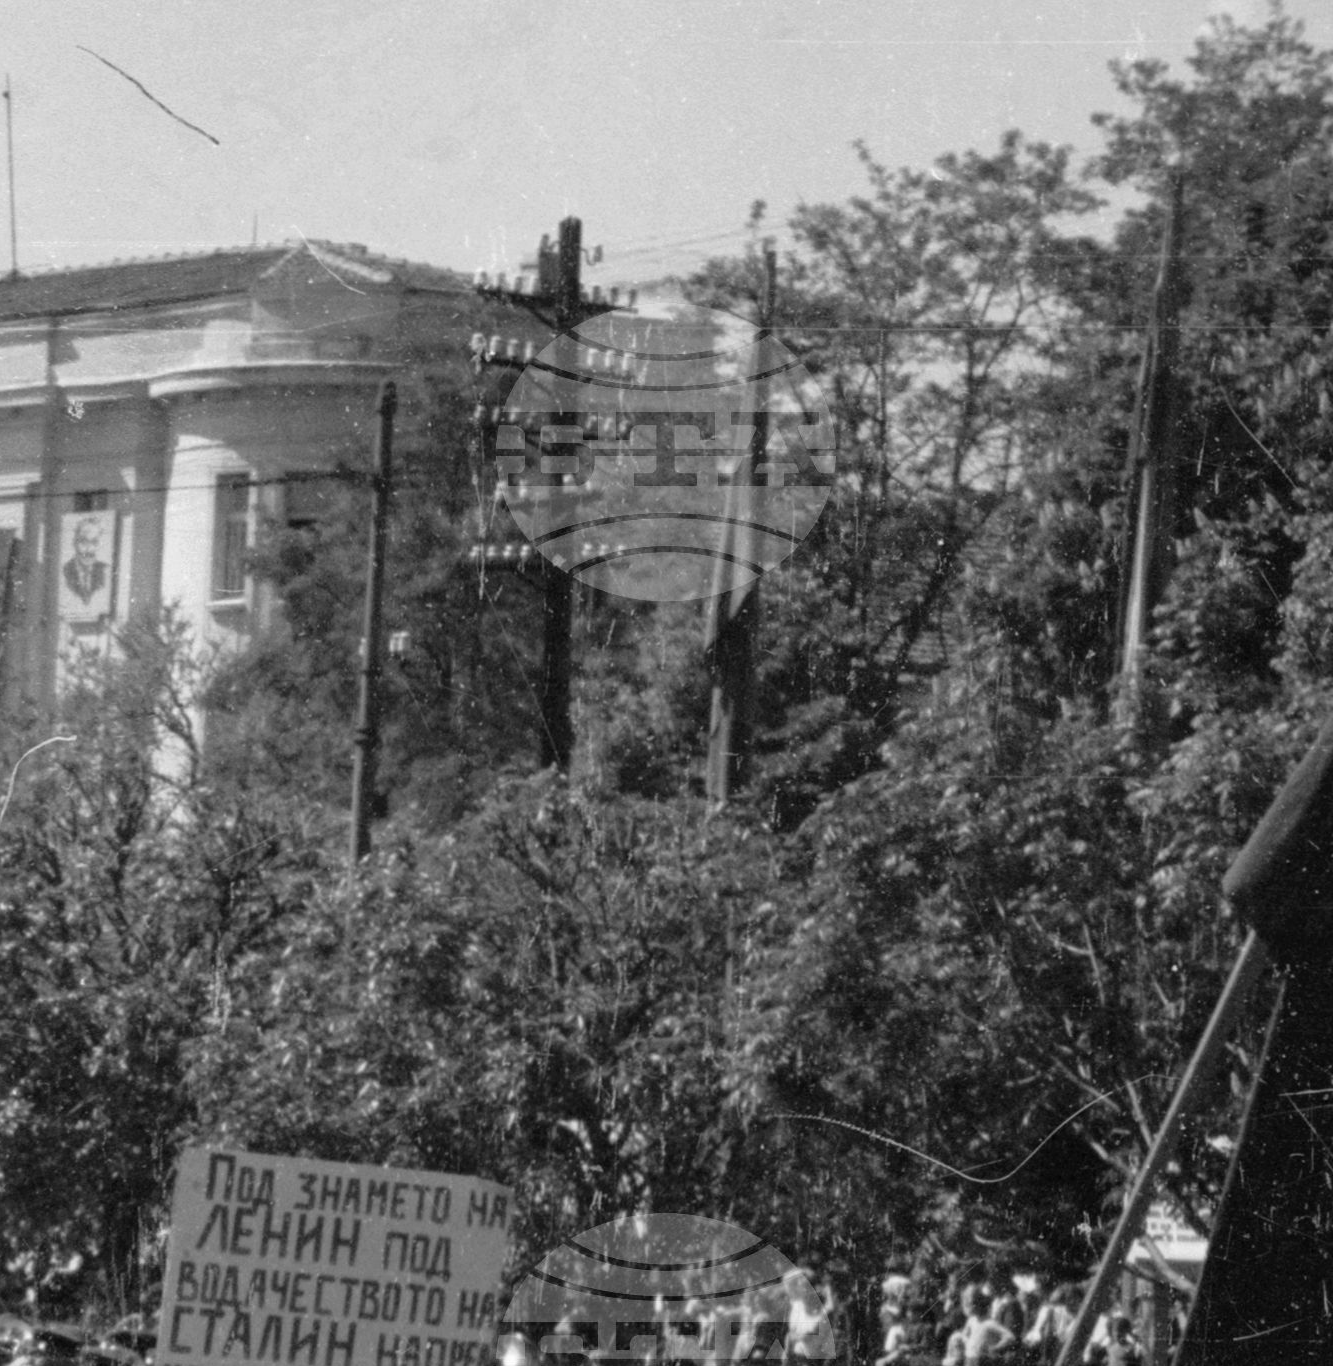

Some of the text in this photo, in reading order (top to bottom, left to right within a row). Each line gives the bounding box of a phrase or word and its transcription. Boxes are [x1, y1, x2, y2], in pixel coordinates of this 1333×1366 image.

[205, 1153, 508, 1229] ПОД ЗНАМЕТО НА
[195, 1203, 452, 1283] ЛЕНИН ПОД
[176, 1260, 496, 1329] ВОДАЧЕСТВОТО НА
